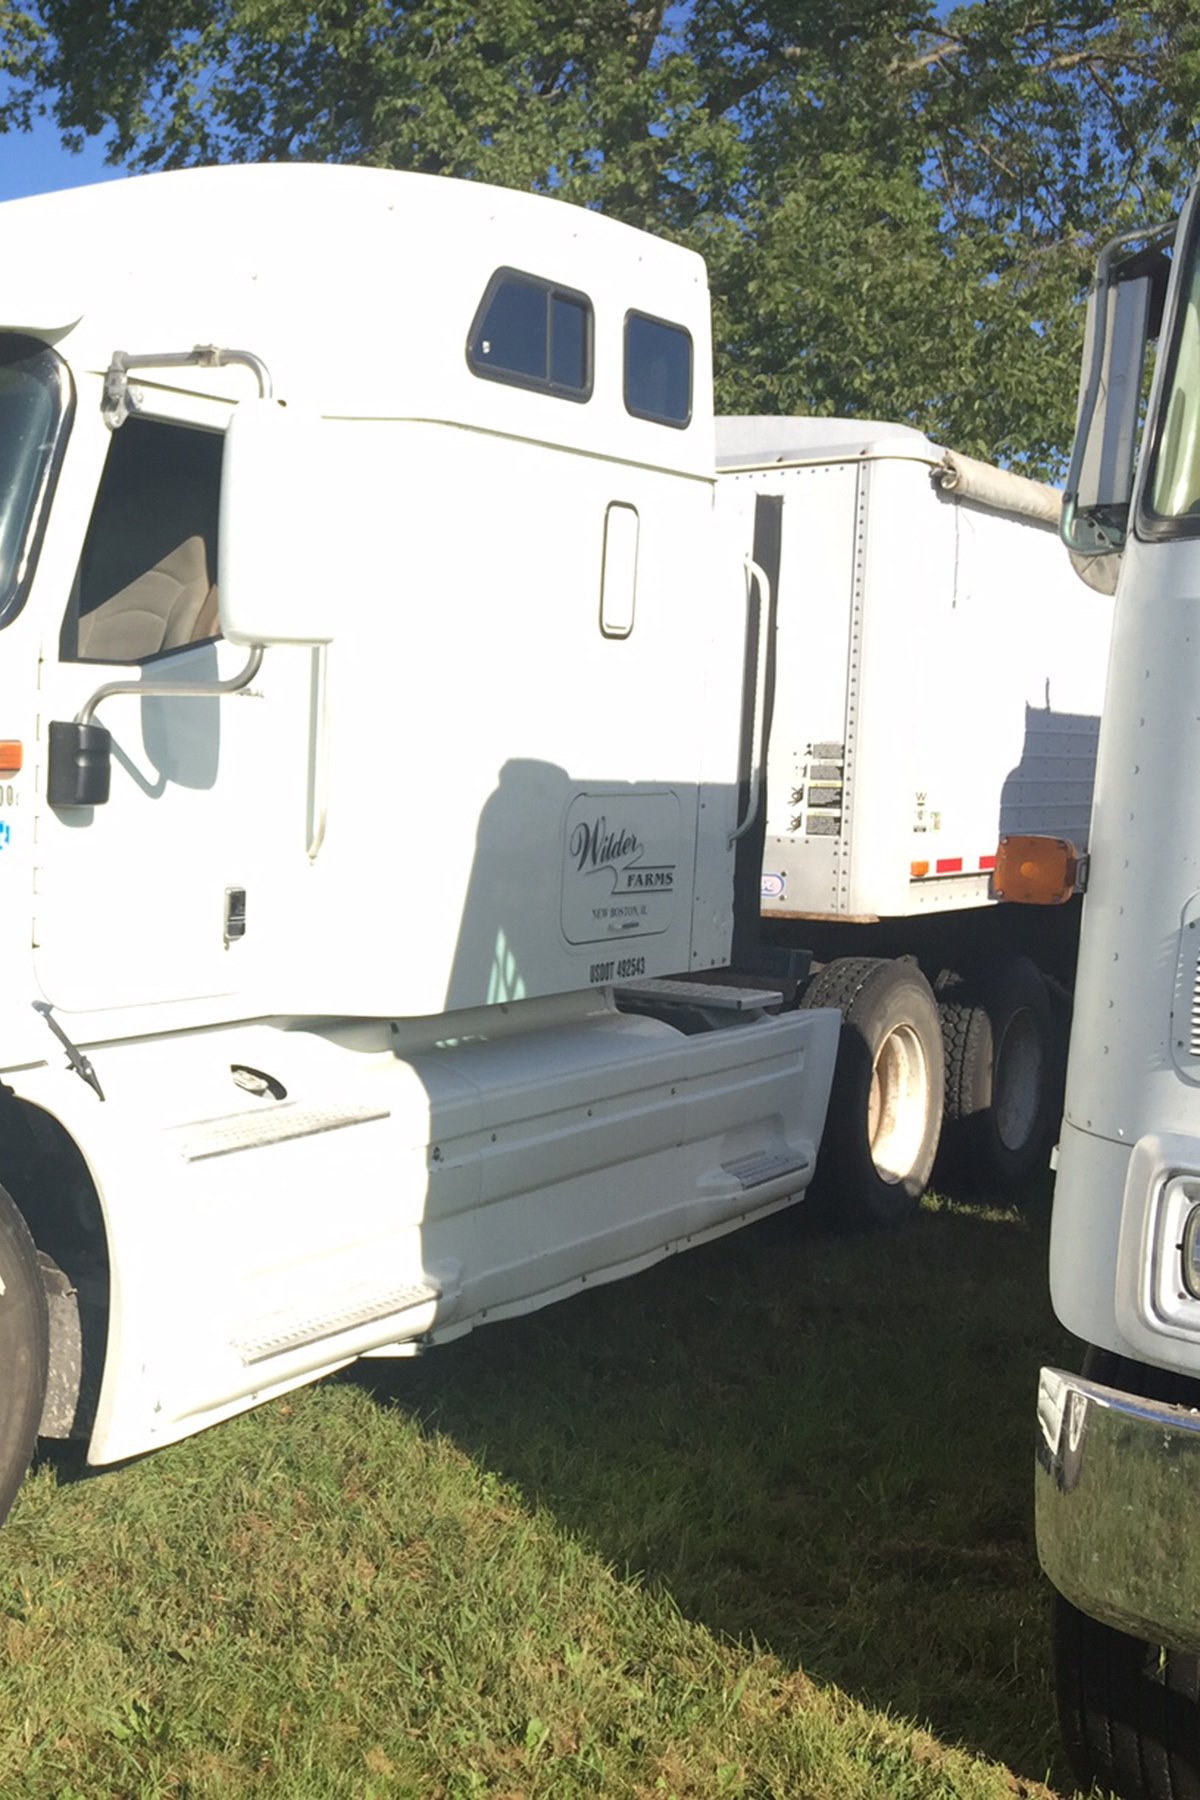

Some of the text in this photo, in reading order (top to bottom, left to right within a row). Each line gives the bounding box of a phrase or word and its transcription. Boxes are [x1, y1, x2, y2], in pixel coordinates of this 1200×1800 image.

[569, 815, 643, 872] Wilder
[626, 871, 674, 888] FARMS
[592, 908, 608, 919] NEW
[589, 956, 646, 983] USDOT 492543
